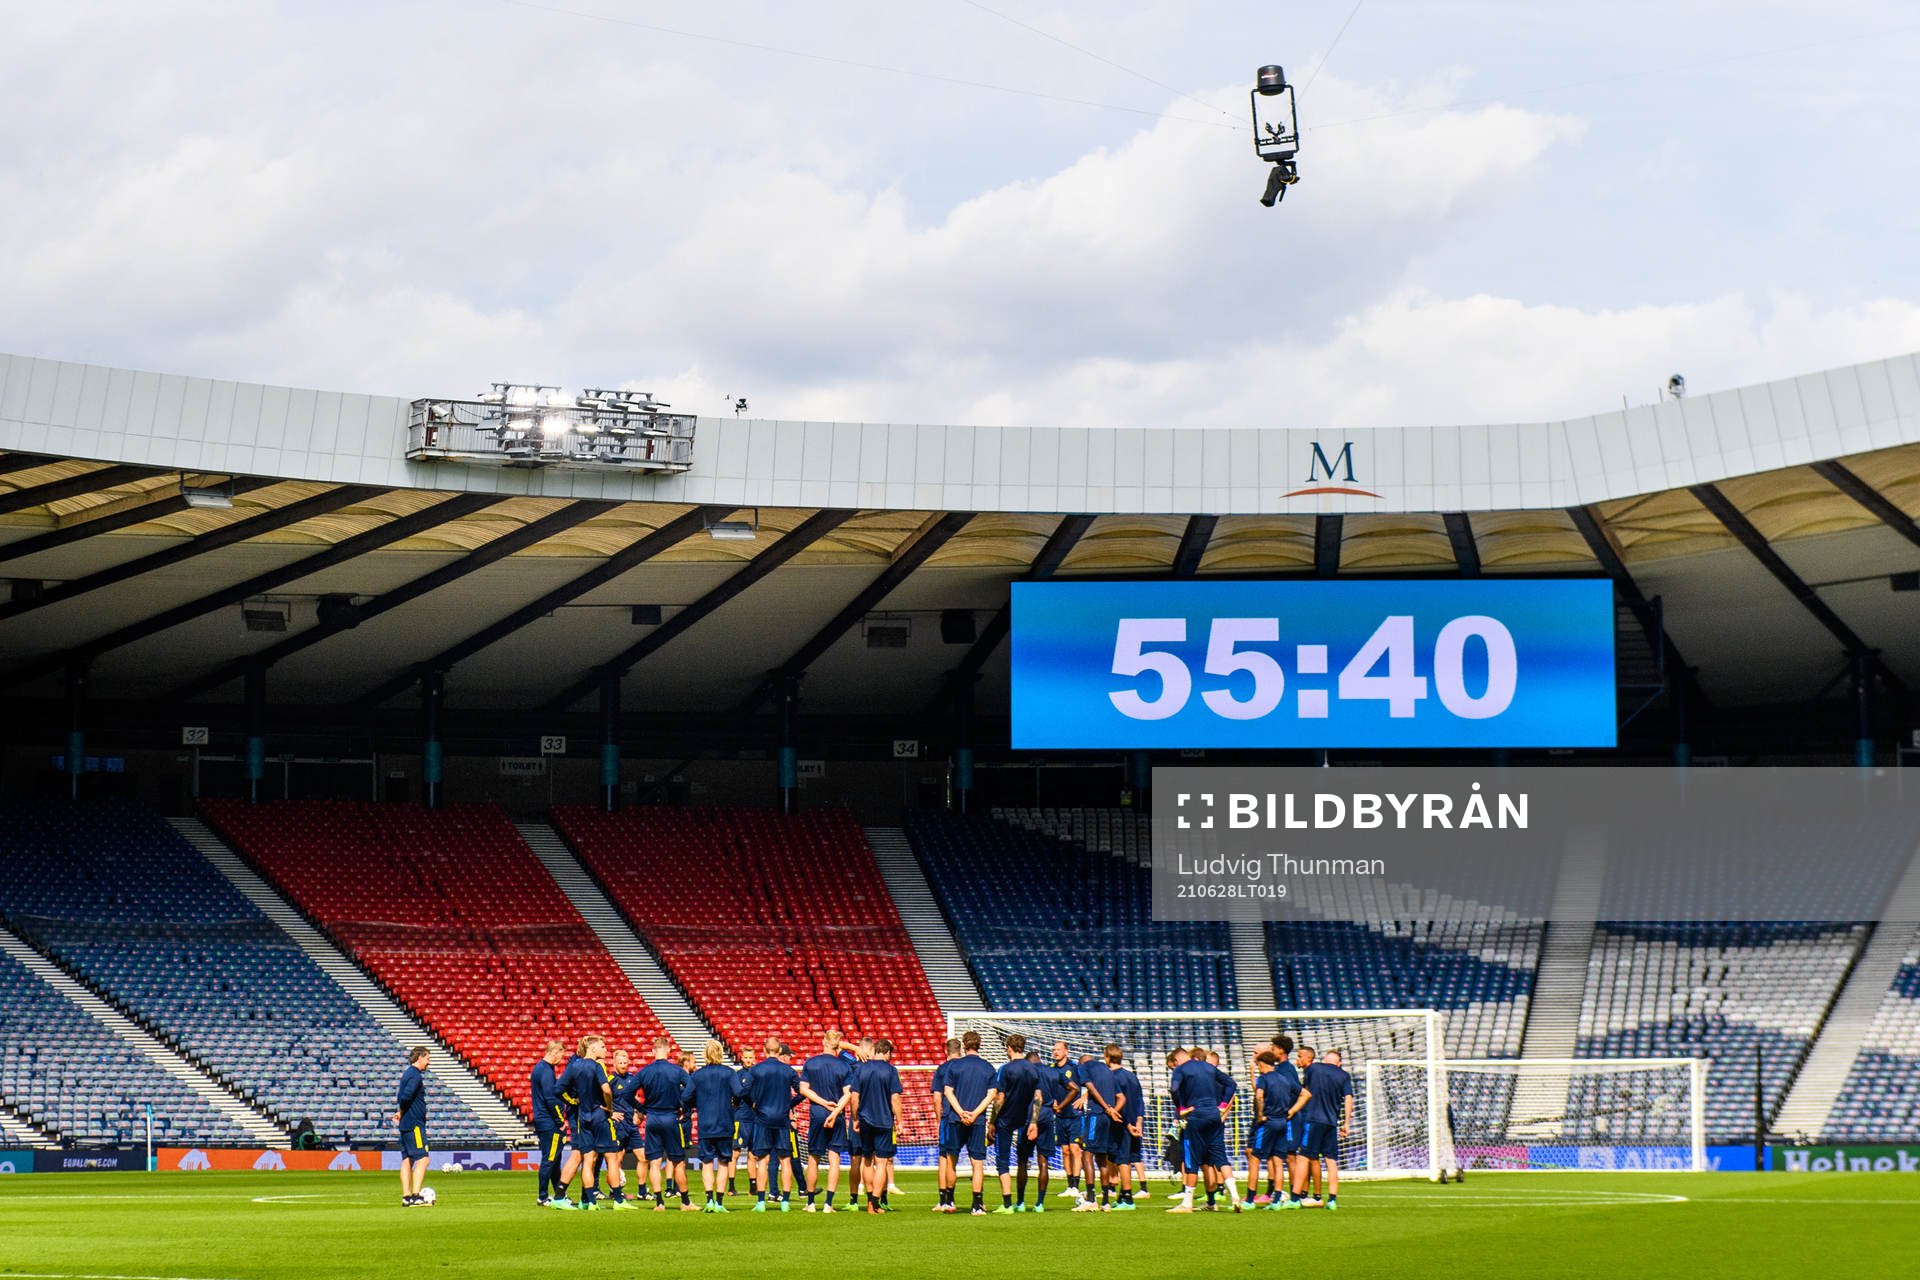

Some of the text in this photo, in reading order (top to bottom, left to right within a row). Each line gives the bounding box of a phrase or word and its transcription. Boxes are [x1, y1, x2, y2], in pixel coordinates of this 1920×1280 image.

[1304, 441, 1359, 483] M
[1108, 615, 1519, 720] 55:40
[186, 730, 205, 742] 32
[544, 738, 562, 750] 33
[896, 742, 915, 755] 34
[507, 762, 537, 770] TOILET
